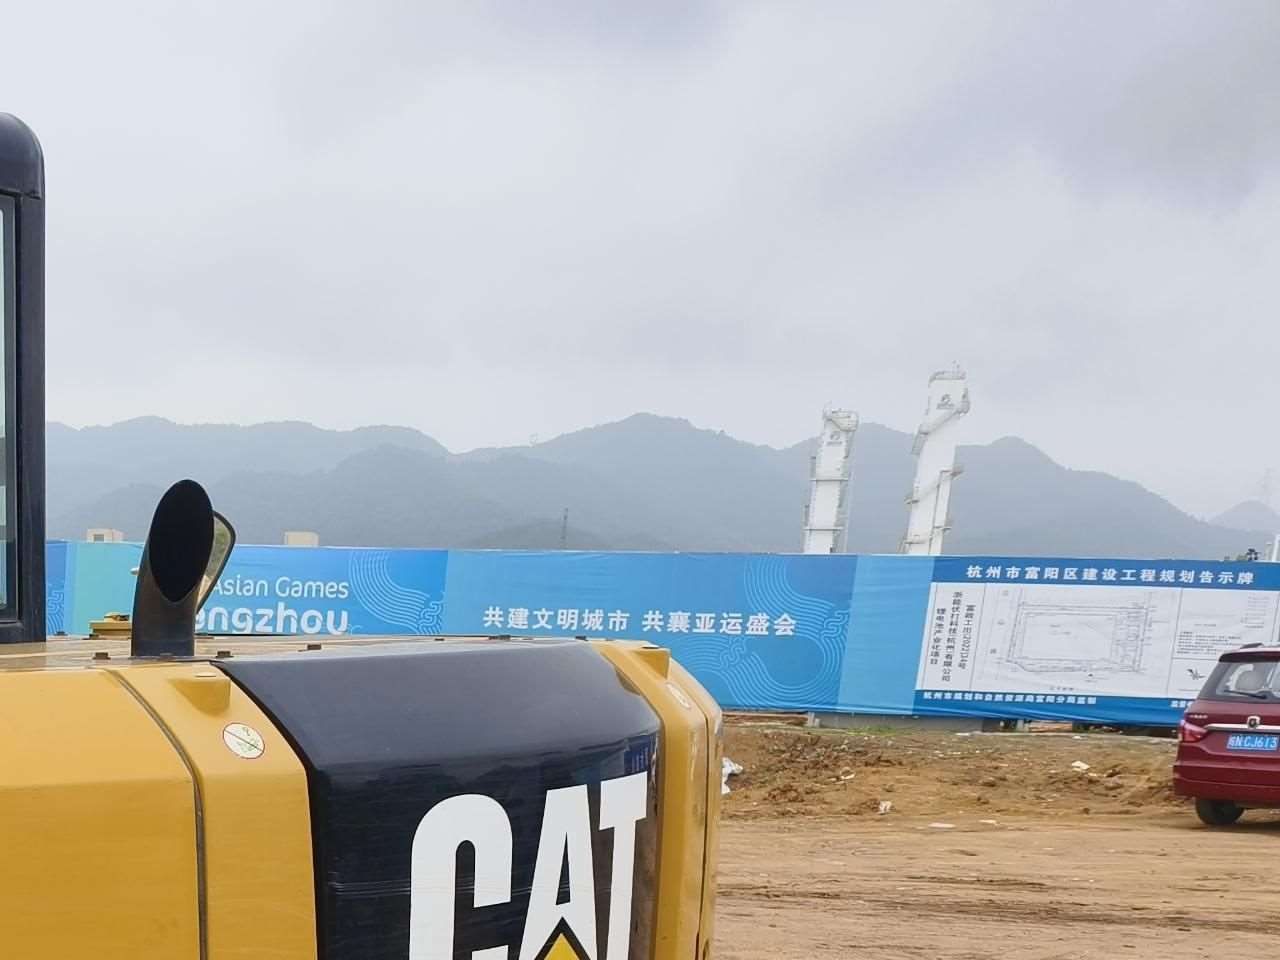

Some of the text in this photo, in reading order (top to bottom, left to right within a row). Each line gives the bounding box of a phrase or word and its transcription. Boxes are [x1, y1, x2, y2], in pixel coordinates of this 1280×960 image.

[966, 565, 1255, 585] 杭州市富阳区建设工程规划告示牌
[275, 576, 349, 598] Games
[483, 606, 797, 636] 共建文明城市 共襄亚运盛会
